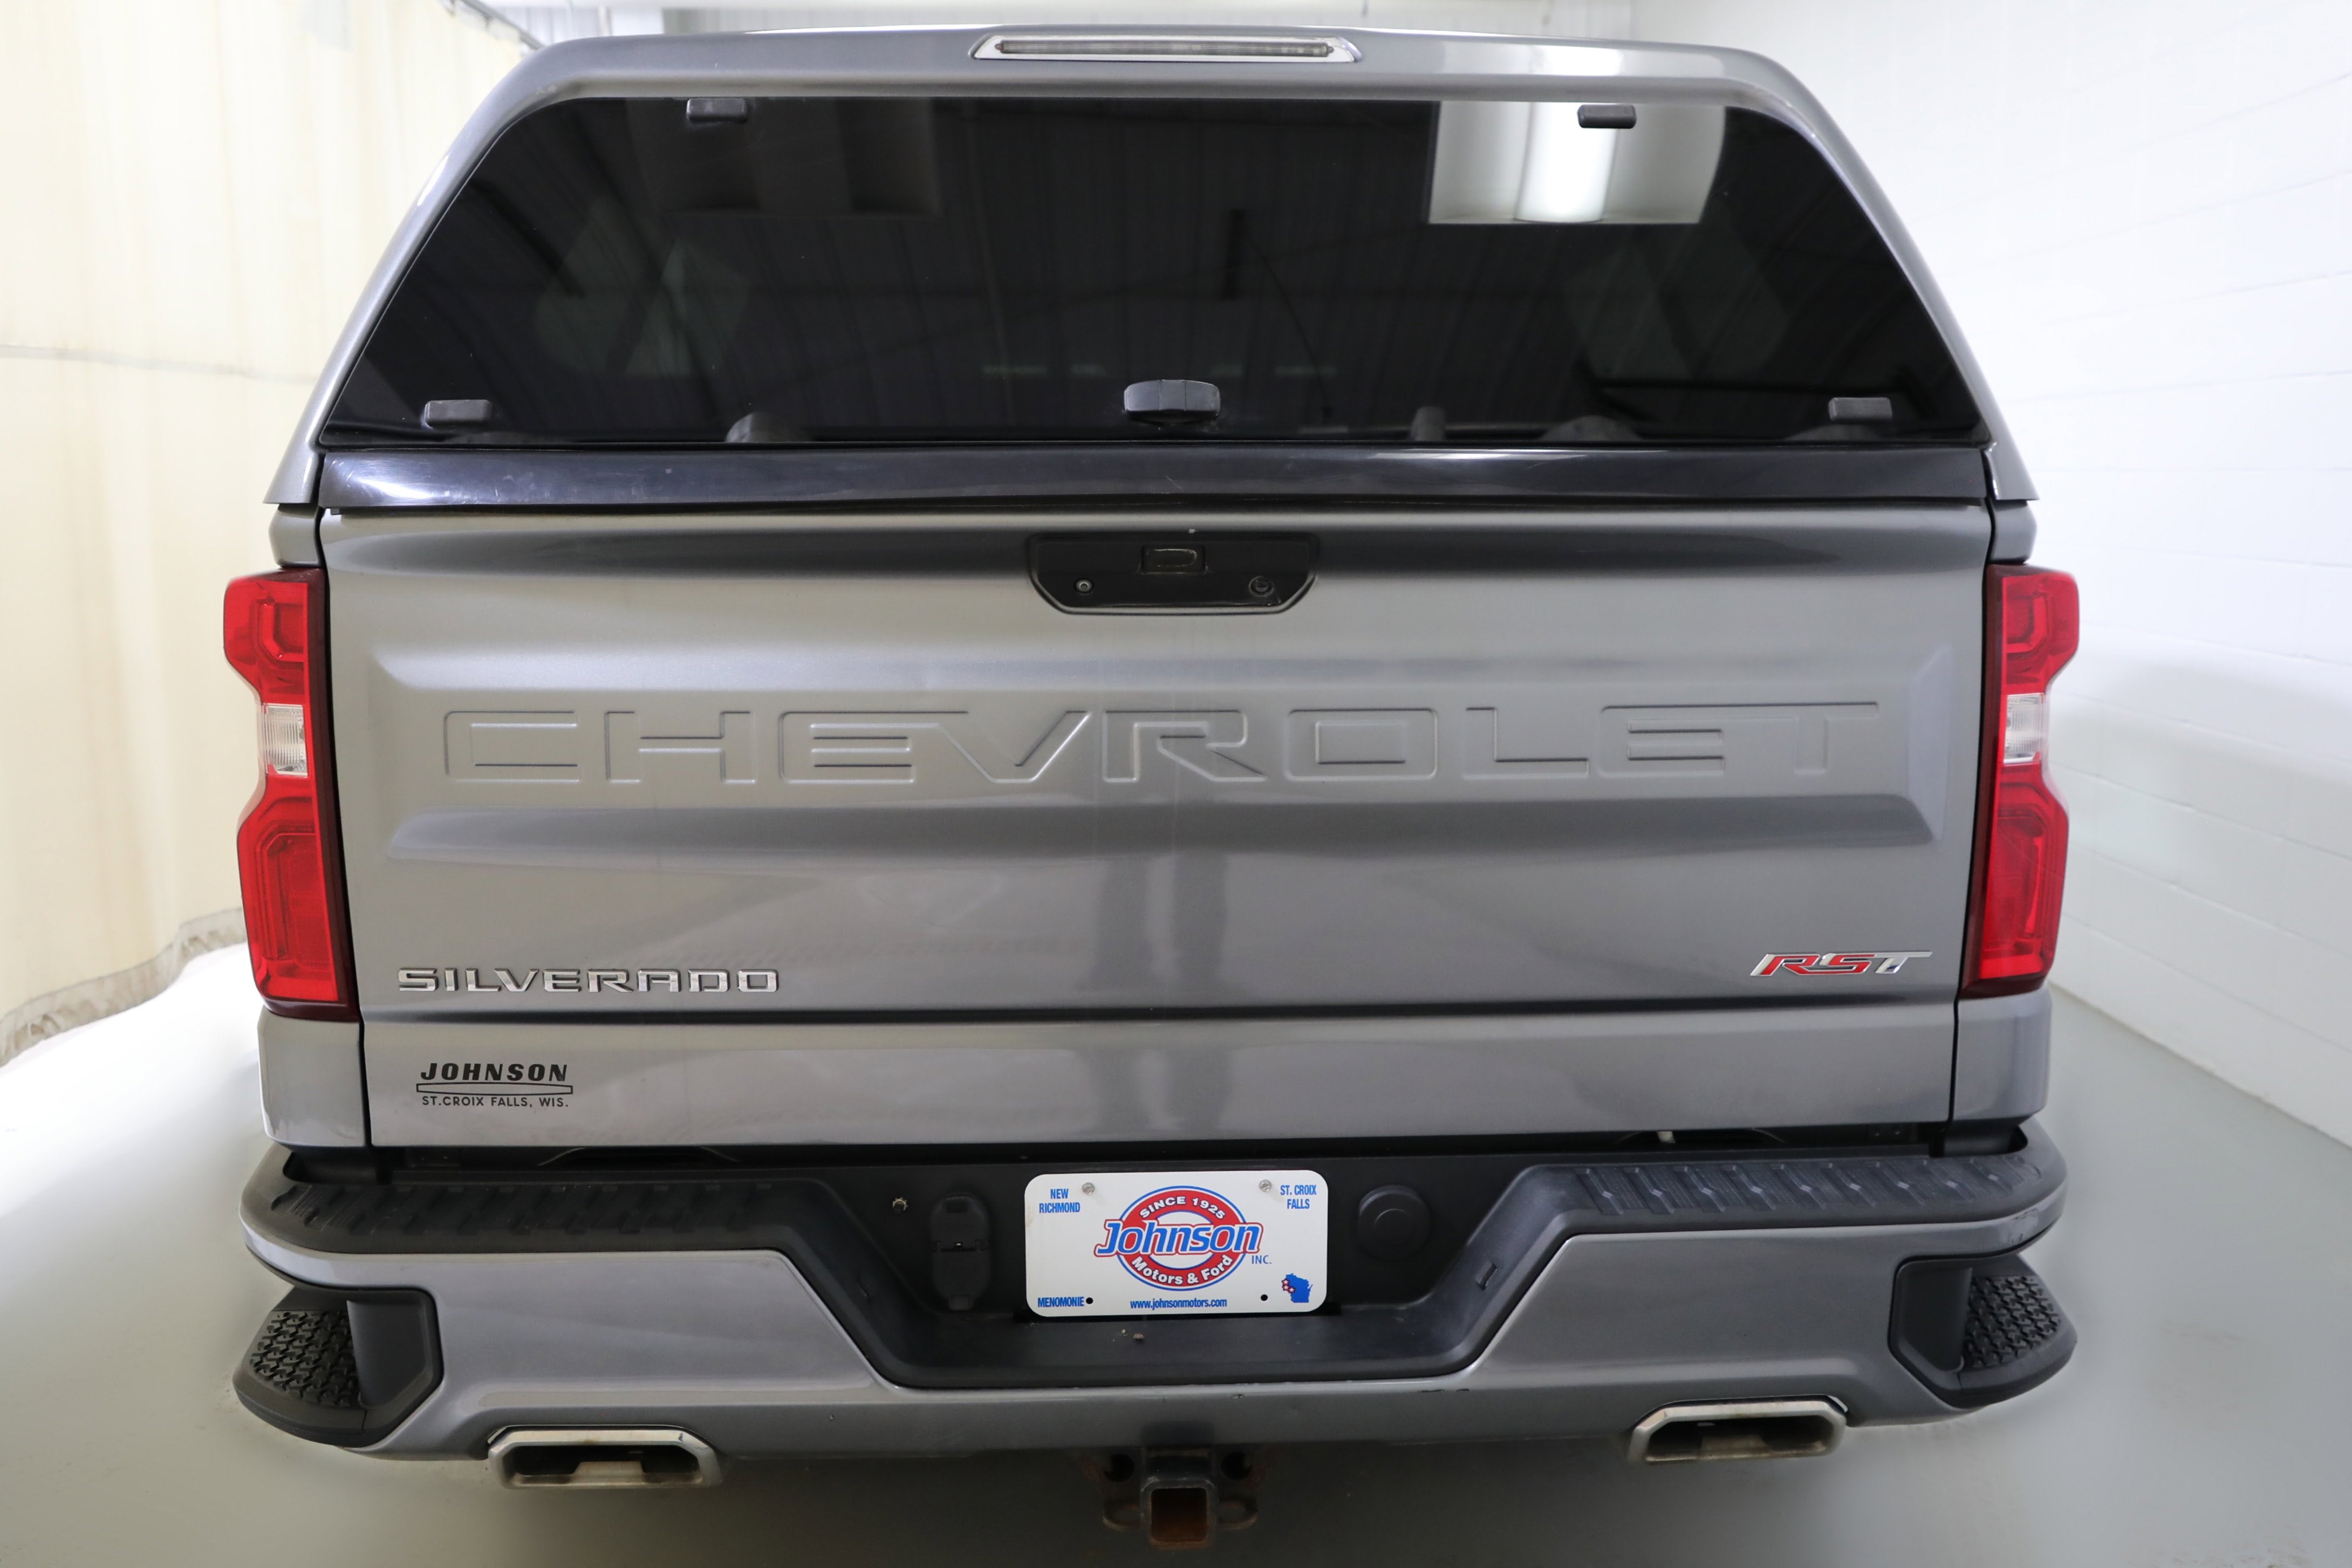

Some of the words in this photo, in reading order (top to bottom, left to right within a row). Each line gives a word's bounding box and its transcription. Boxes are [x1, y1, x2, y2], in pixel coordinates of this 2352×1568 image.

[444, 701, 1879, 783] CHEVROLET
[1750, 951, 1933, 976] RST
[398, 968, 780, 993] SILVERADO
[420, 1063, 568, 1081] JOHNSON
[490, 1096, 533, 1108] FALLS,
[539, 1097, 569, 1107] WIS.
[1050, 1189, 1069, 1199] NEW
[1280, 1186, 1293, 1195] ST.
[1294, 1185, 1317, 1195] CROIX
[1039, 1202, 1081, 1213] RICHMOND
[1139, 1196, 1186, 1219] SINCE
[1192, 1197, 1226, 1220] 1925
[1287, 1199, 1310, 1209] FALLS
[1097, 1221, 1260, 1254] Johnson
[1251, 1255, 1272, 1264] INC.
[1131, 1256, 1184, 1285] Motors
[1187, 1274, 1199, 1285] &
[1201, 1255, 1233, 1281] Ford
[1037, 1297, 1085, 1307] MENOMONIE
[1130, 1297, 1227, 1310] www.johnsonmotors.com
